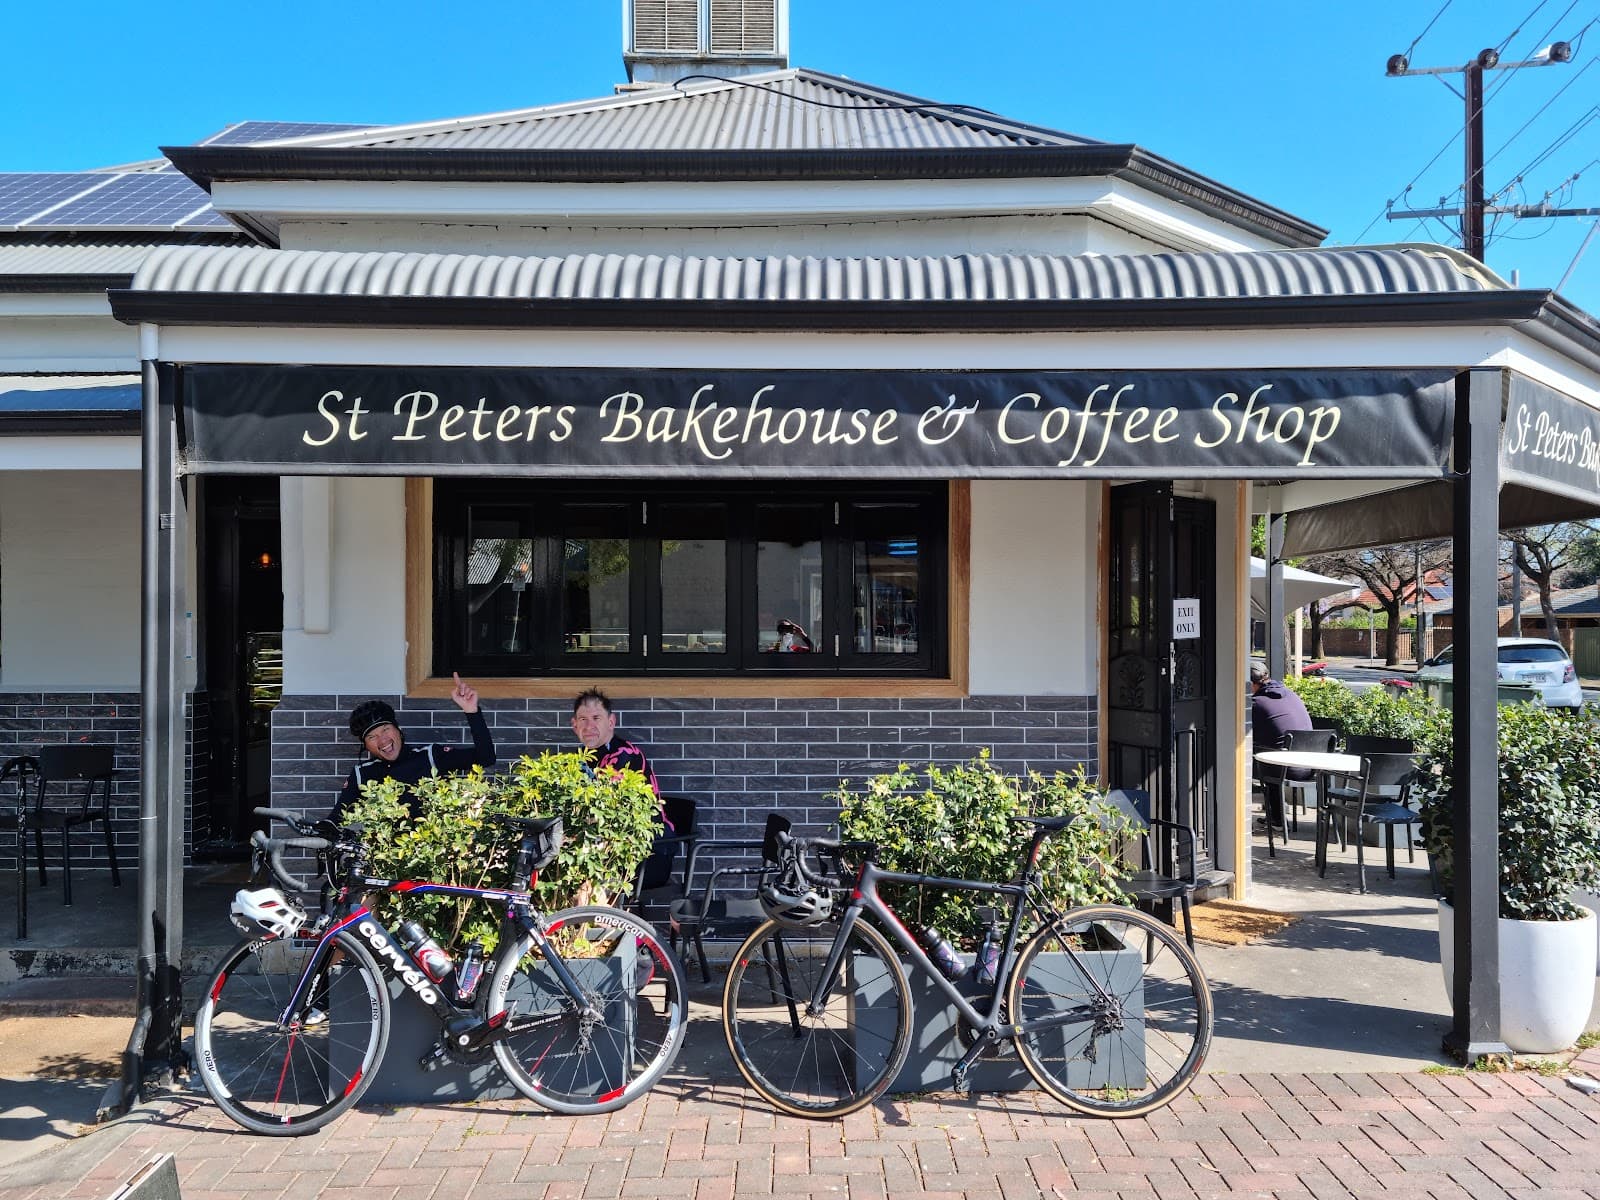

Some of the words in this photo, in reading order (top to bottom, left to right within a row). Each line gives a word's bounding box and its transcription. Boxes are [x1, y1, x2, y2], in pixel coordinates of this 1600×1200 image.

[302, 390, 370, 446] St
[391, 390, 576, 442] Peters
[599, 384, 899, 460] Bakehouse
[916, 394, 981, 446] &
[997, 384, 1180, 467] Coffee
[1194, 384, 1342, 467] Shop
[1508, 403, 1532, 455] St
[1531, 410, 1579, 465] Peters
[1177, 607, 1194, 617] EXIT
[1176, 623, 1196, 633] ONLY
[594, 915, 645, 938] american
